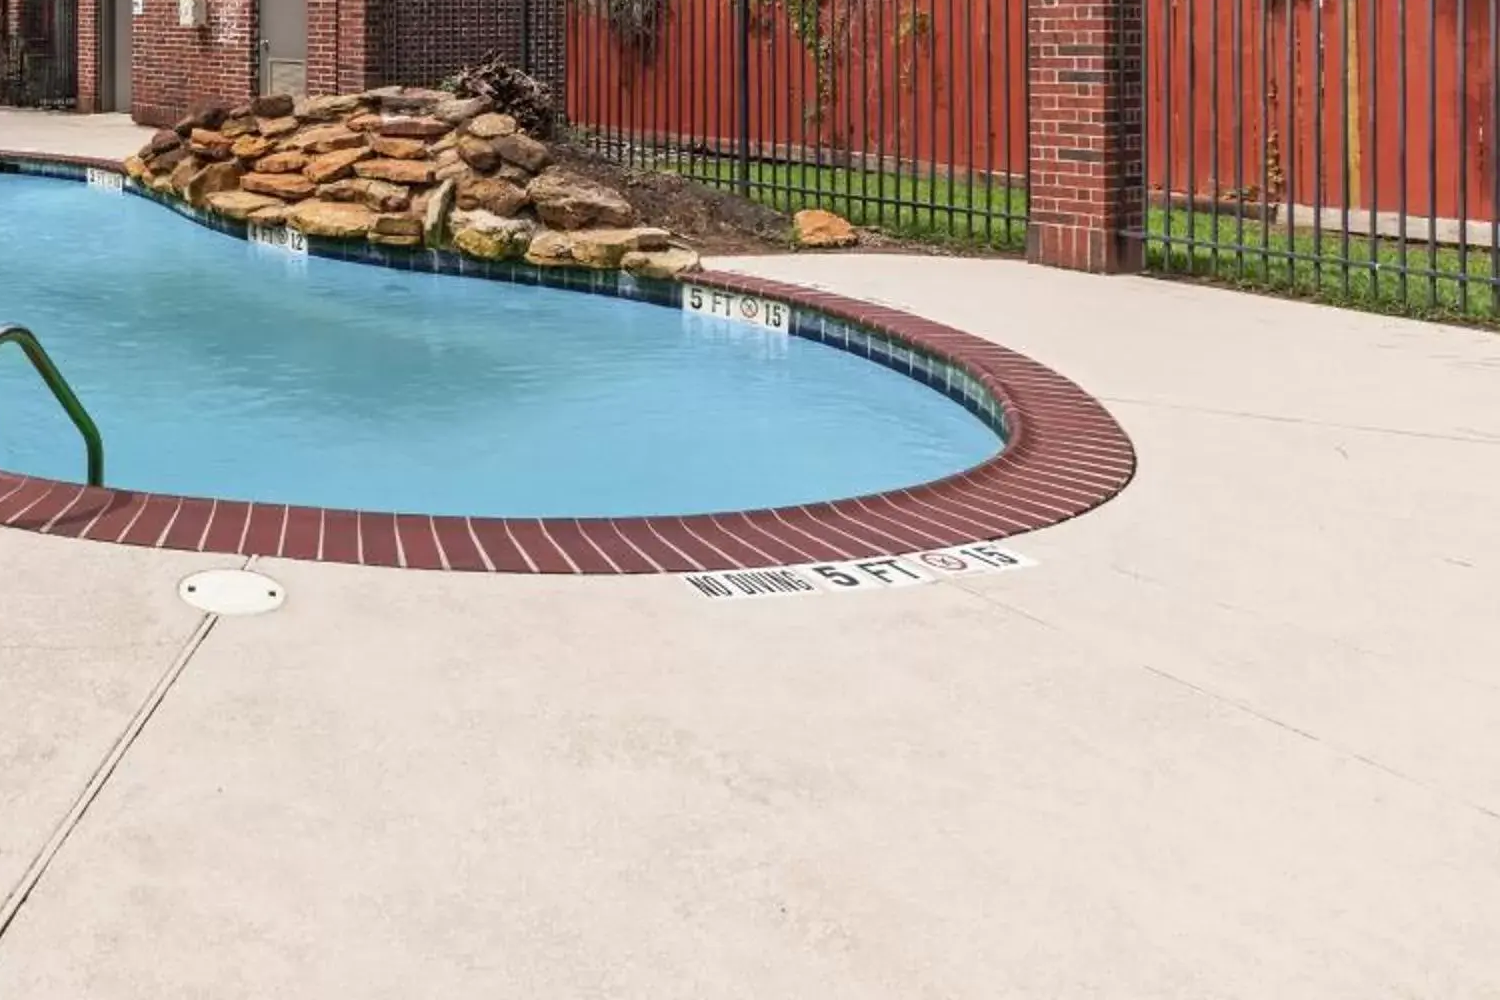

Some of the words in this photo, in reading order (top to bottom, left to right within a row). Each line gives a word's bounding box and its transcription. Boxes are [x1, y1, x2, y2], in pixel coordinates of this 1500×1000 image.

[689, 287, 703, 310] 5
[711, 291, 735, 317] FT
[685, 574, 733, 597] NO
[723, 570, 815, 596] DIVING
[811, 565, 860, 587] 5
[857, 559, 921, 584] FT
